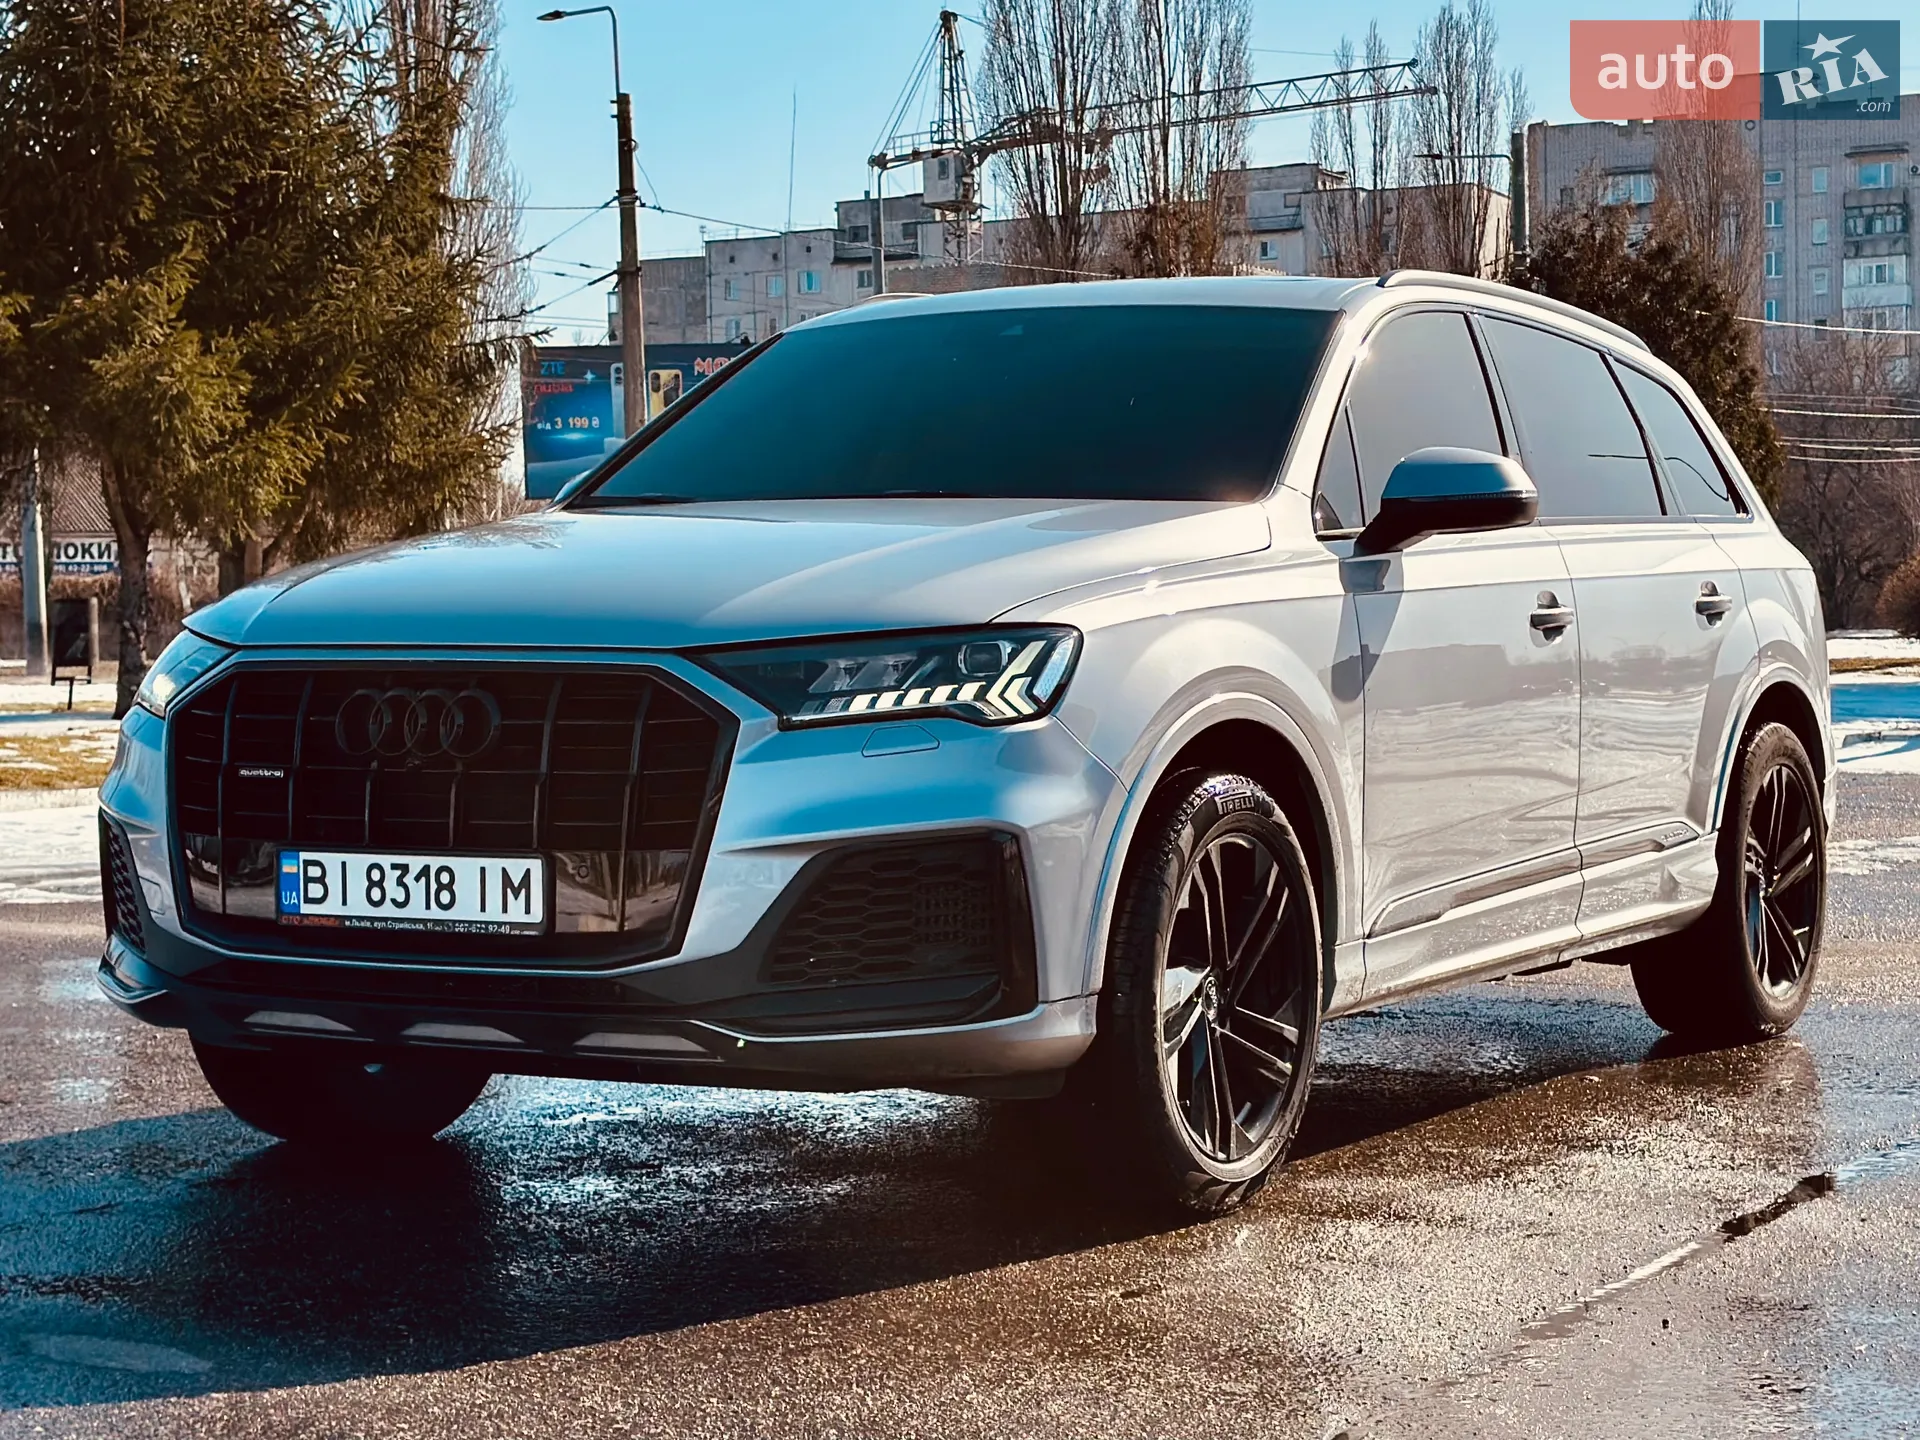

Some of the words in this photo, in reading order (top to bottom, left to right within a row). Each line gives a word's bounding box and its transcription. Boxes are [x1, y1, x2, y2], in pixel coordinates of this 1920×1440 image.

[541, 361, 565, 375] ZTE
[554, 417, 563, 429] 3
[568, 416, 589, 429] 199
[240, 768, 281, 777] quattro
[1214, 789, 1255, 815] PIRELLI
[302, 858, 348, 907] BI
[365, 862, 457, 912] 8318
[282, 890, 299, 905] UA
